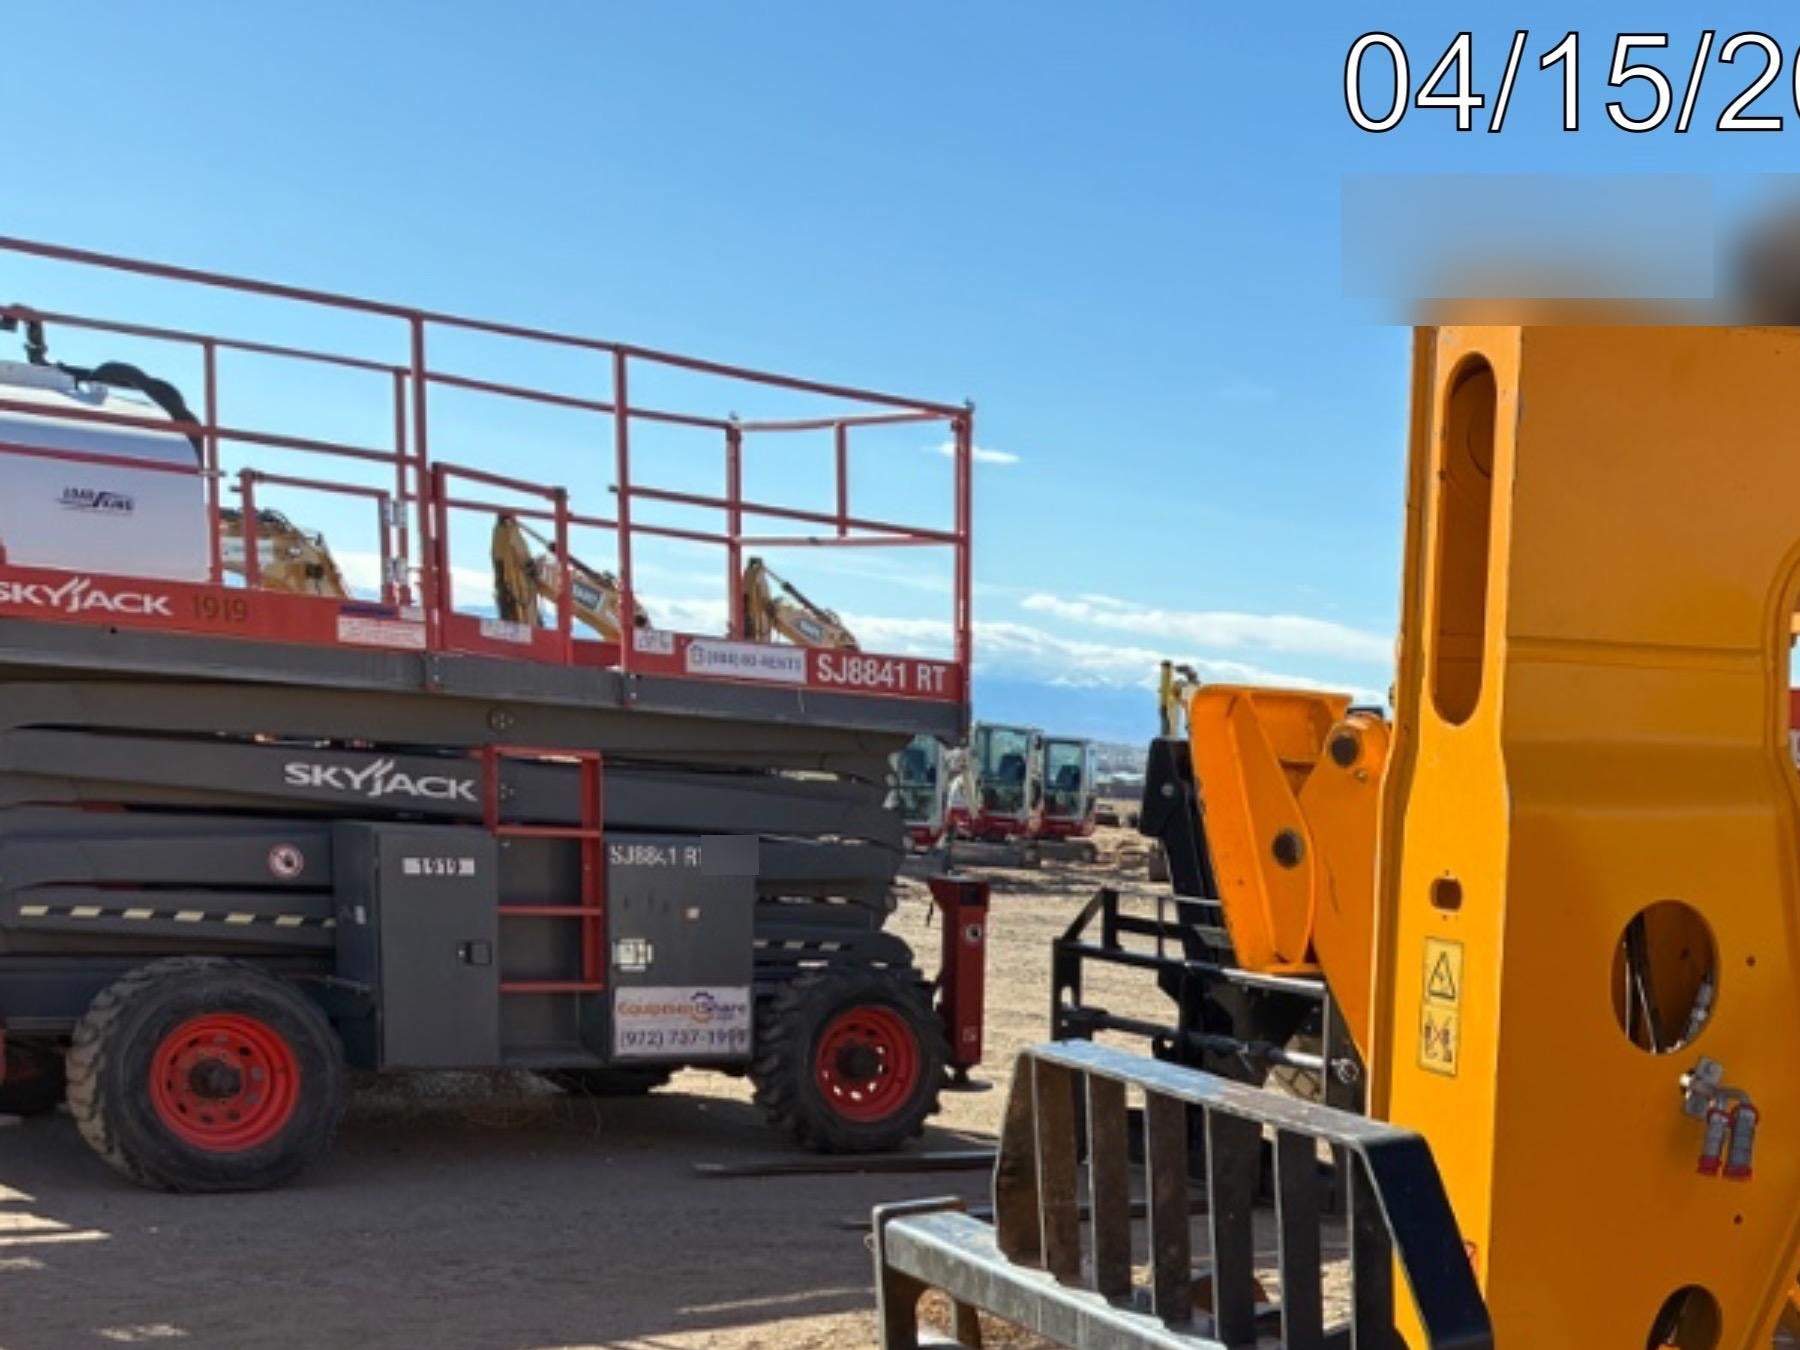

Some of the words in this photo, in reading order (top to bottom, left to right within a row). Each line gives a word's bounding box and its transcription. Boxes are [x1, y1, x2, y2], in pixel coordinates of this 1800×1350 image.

[193, 596, 248, 623] 1919
[816, 652, 906, 690] SJ8841
[917, 664, 947, 693] RT
[284, 758, 478, 802] SKYJACK
[684, 845, 702, 868] R
